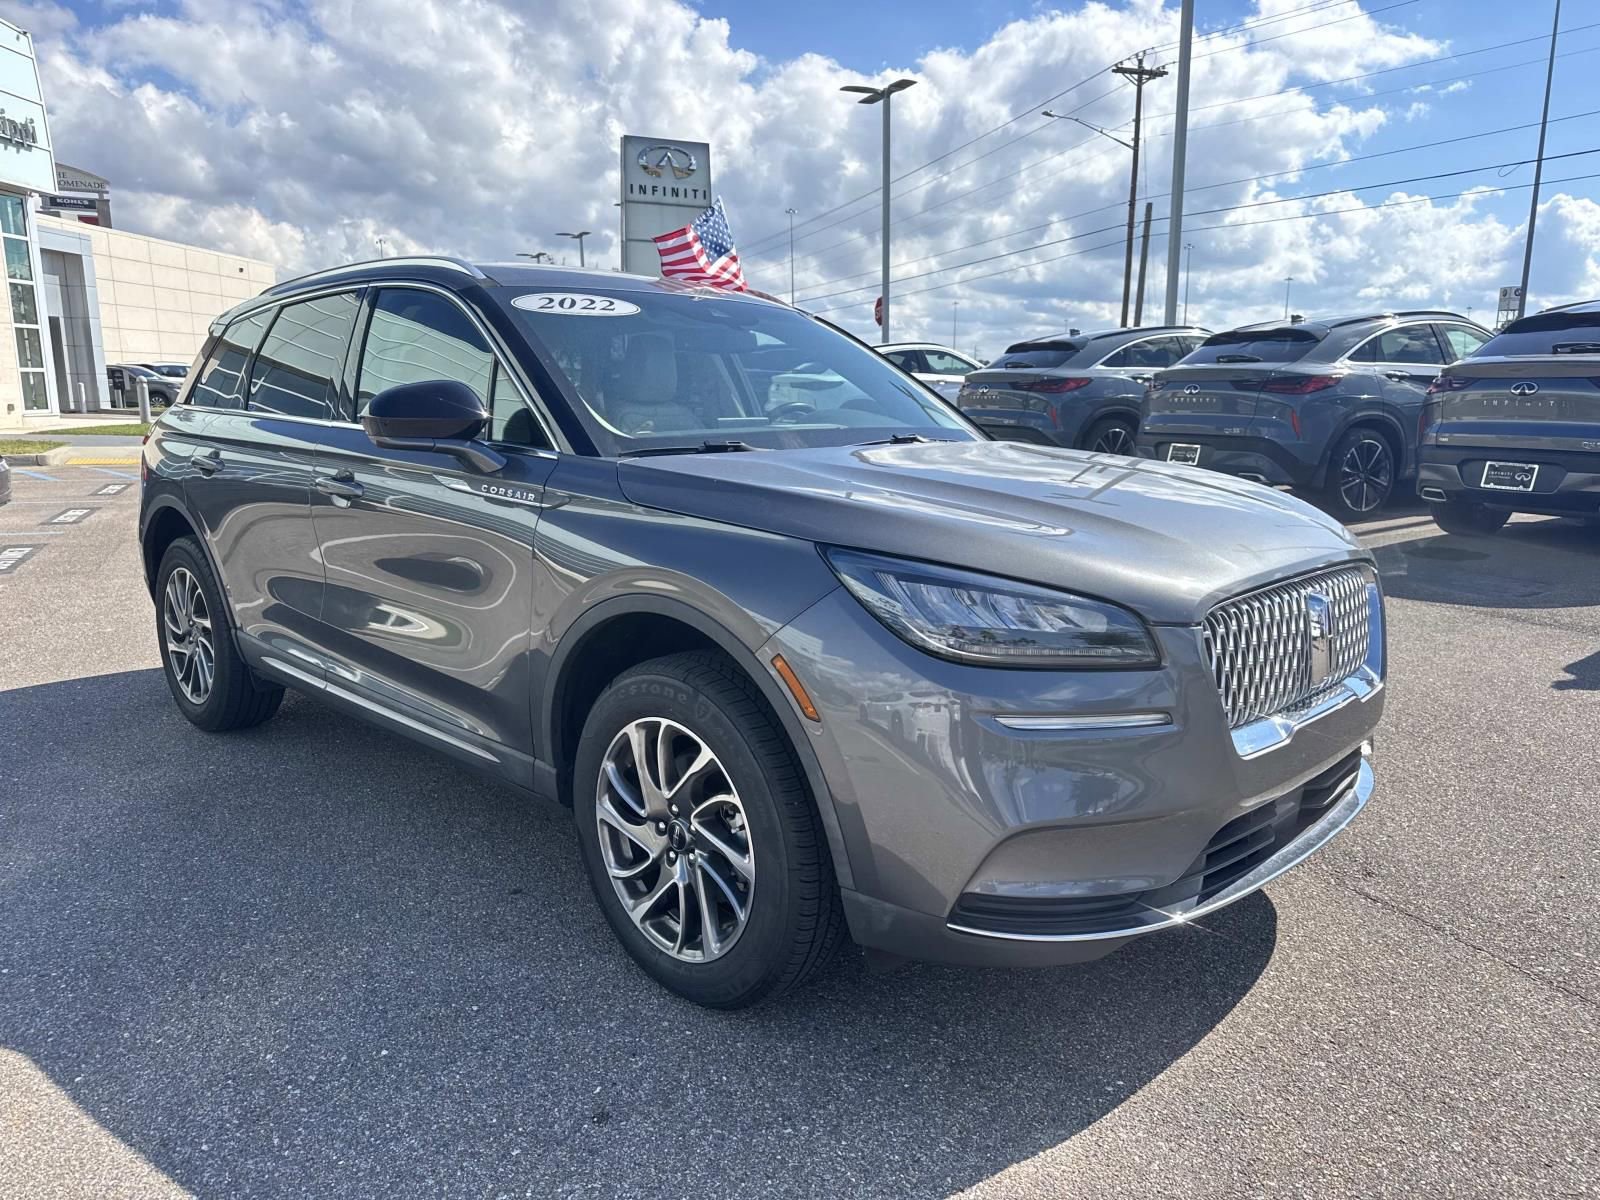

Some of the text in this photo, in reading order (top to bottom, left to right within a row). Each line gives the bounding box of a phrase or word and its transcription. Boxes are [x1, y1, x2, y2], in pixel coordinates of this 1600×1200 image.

[58, 179, 105, 189] OMENADE
[630, 184, 707, 200] INFINITI
[537, 297, 615, 312] 2022
[481, 484, 536, 501] CORSAIR
